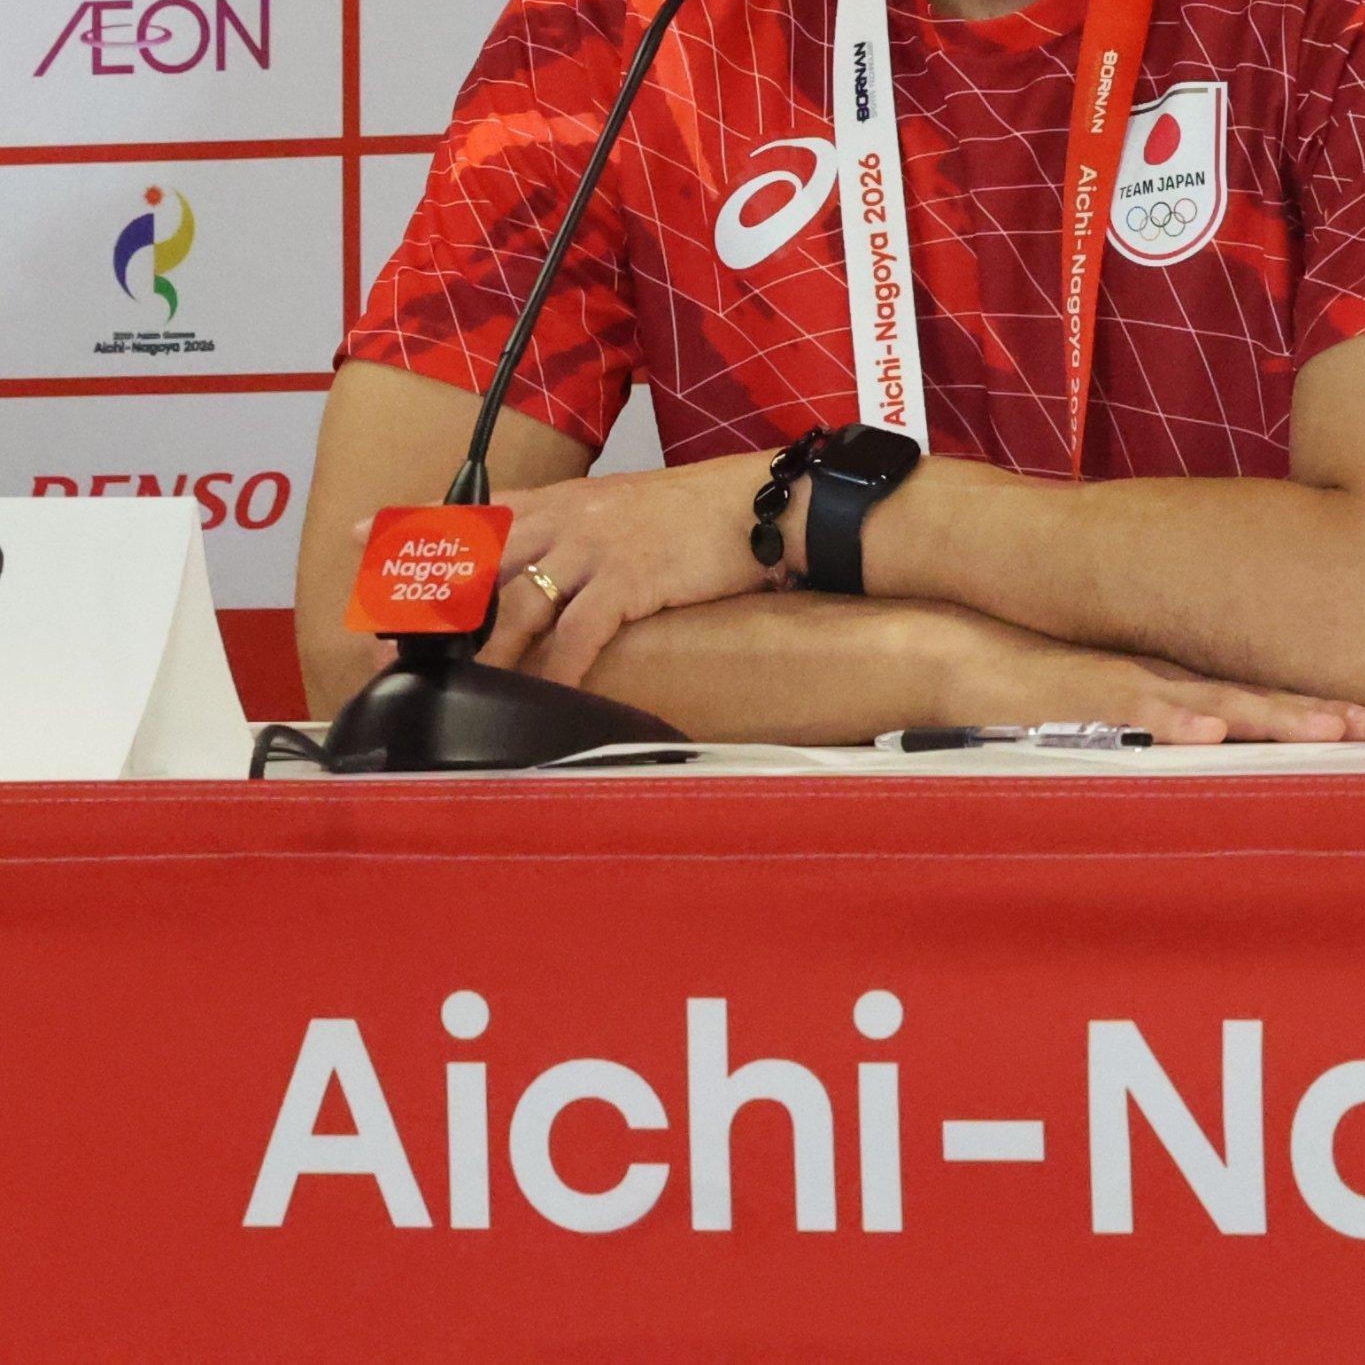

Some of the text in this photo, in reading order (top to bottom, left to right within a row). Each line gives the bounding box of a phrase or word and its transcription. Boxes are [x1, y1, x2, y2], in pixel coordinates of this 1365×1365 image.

[854, 41, 871, 124] BORNAN
[1090, 49, 1118, 134] BORNAN
[1119, 170, 1206, 201] TEAM JAPAN
[858, 152, 907, 428] Aichi-Nagoya 2026
[1066, 164, 1098, 369] Aichi-Nagoya
[382, 558, 474, 581] Nagoya
[398, 538, 470, 557] Aichi-
[390, 582, 451, 600] 2026
